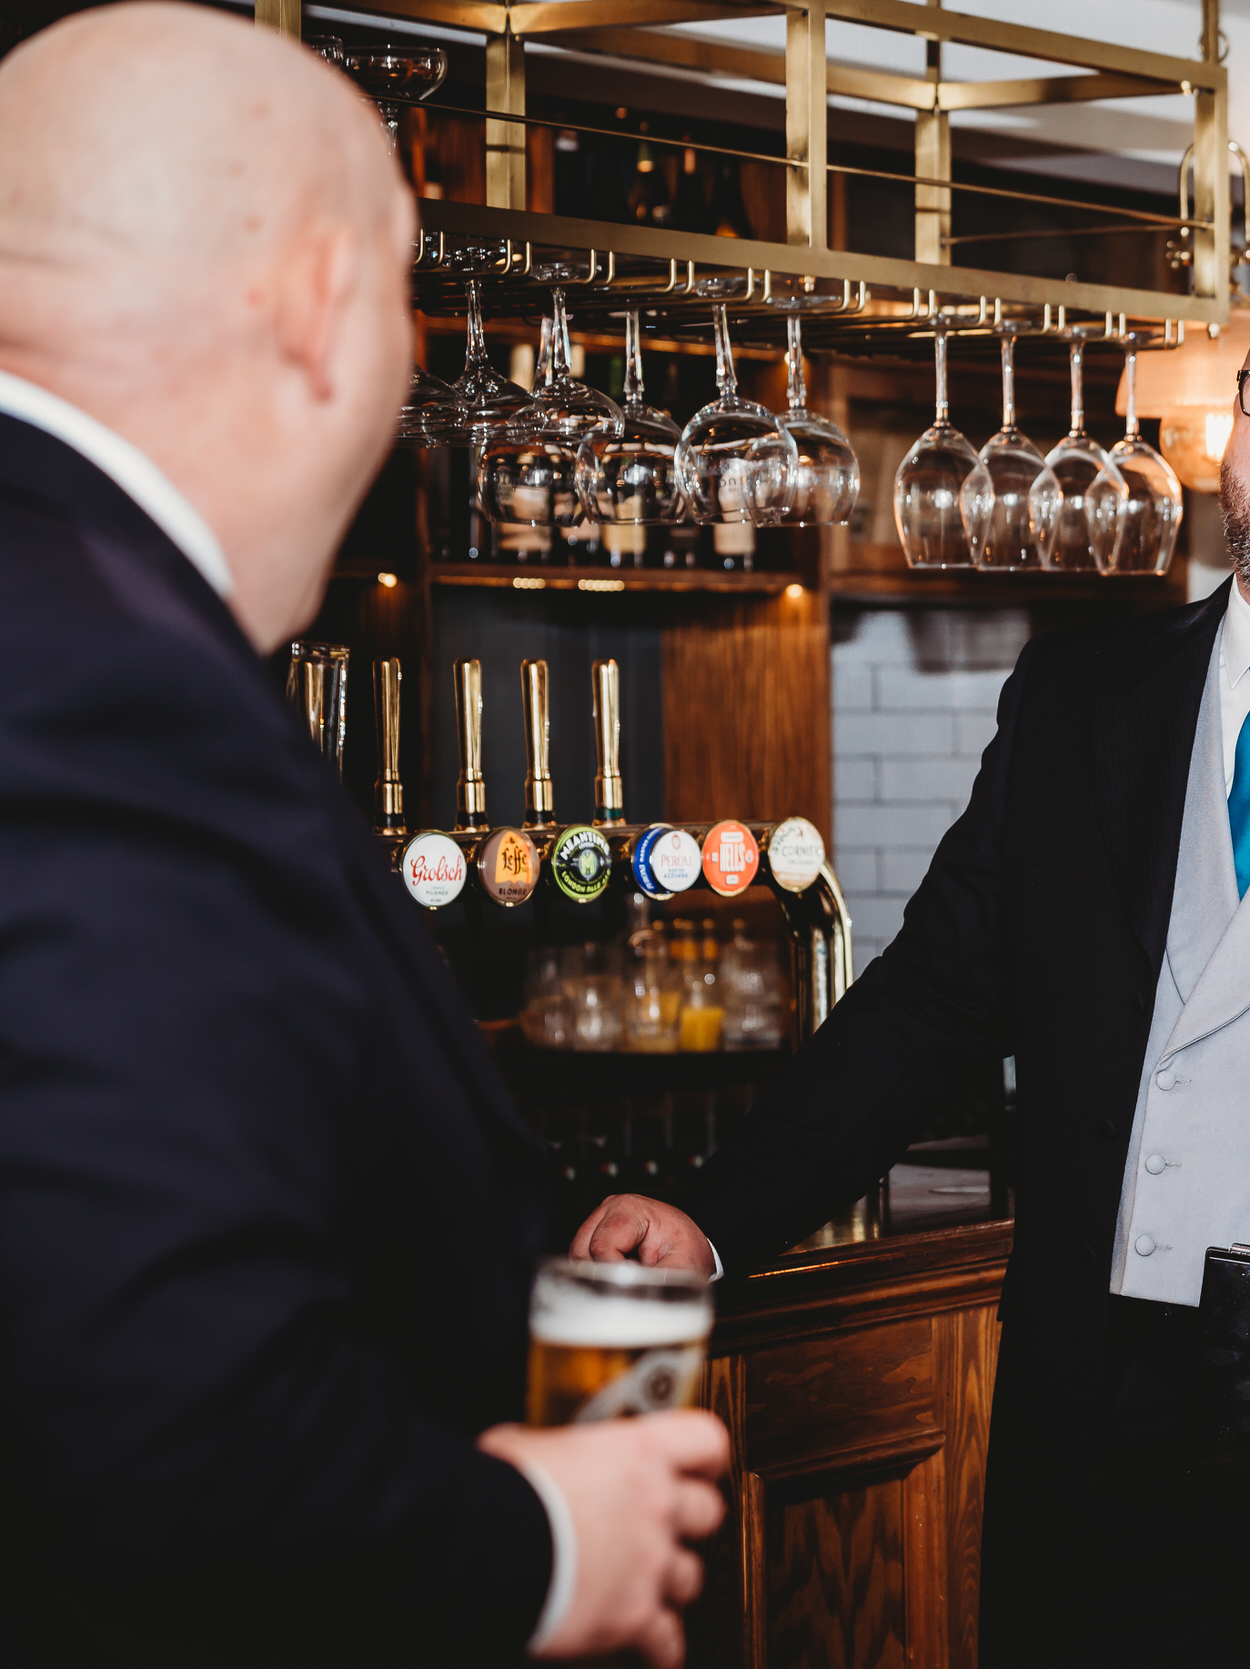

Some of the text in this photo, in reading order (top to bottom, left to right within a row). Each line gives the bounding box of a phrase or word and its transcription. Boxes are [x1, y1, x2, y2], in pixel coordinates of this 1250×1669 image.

[501, 845, 527, 875] Leffe
[560, 831, 610, 860] MEANTIME
[719, 843, 745, 872] HELLS
[410, 855, 462, 886] Grolsch
[660, 854, 692, 867] PERONI
[561, 871, 586, 892] LONDON
[586, 882, 601, 892] PALE
